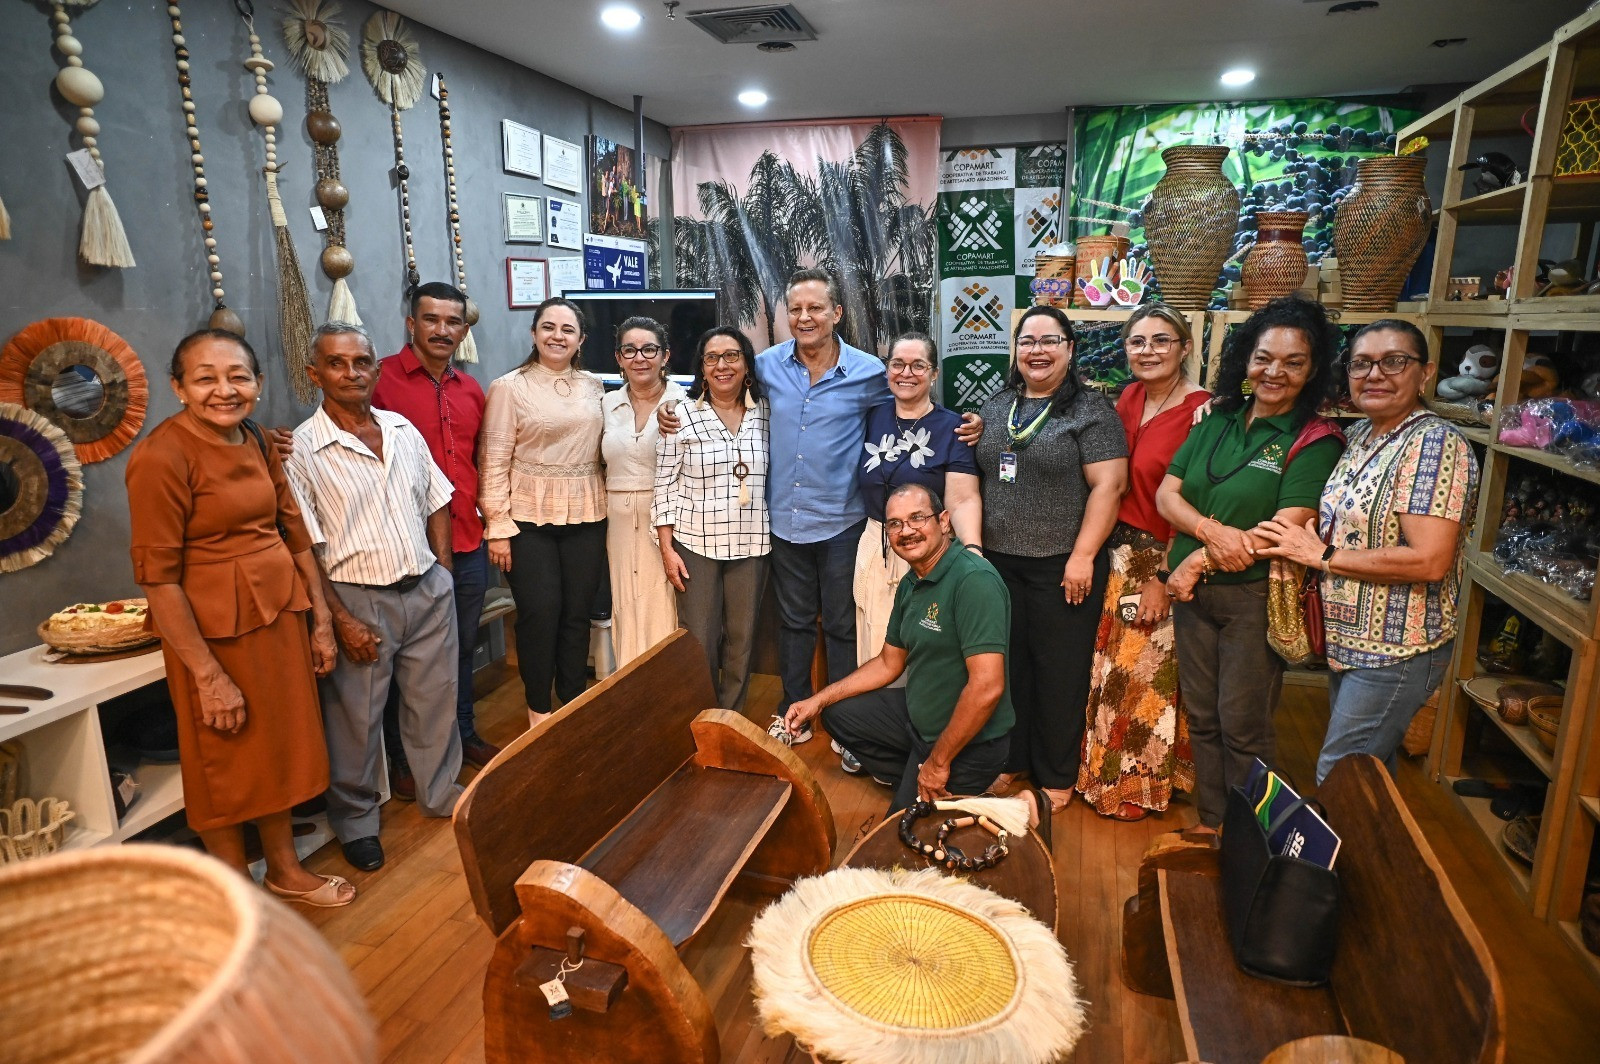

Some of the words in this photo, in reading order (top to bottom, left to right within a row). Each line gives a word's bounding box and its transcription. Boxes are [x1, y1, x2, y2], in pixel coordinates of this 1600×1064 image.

[953, 161, 994, 171] COPAMART
[956, 252, 995, 260] COPAMART
[623, 255, 639, 269] VALE
[958, 333, 997, 341] COPAMART
